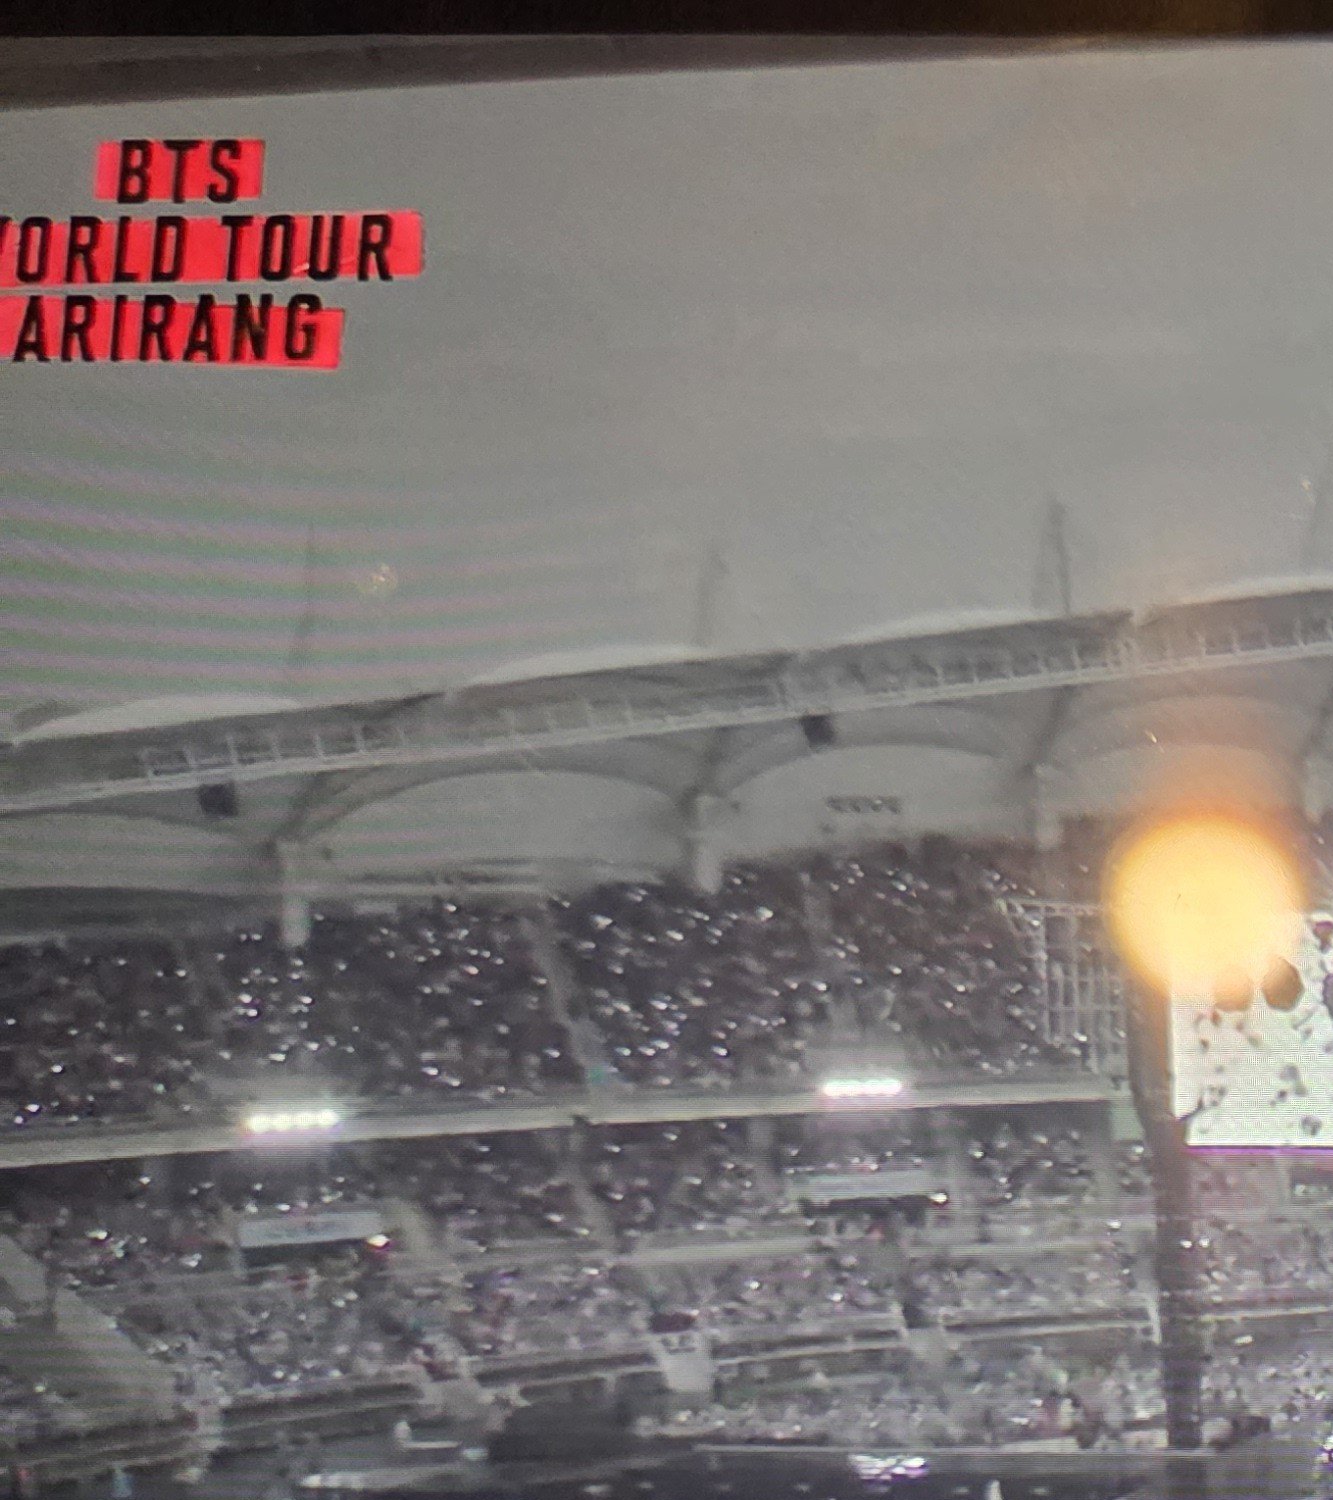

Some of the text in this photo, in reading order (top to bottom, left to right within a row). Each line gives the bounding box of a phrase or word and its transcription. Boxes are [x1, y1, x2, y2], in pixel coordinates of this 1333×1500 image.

[117, 139, 242, 204] BTS
[0, 213, 394, 283] ORLD TOUR
[13, 293, 323, 362] ARIRANG
